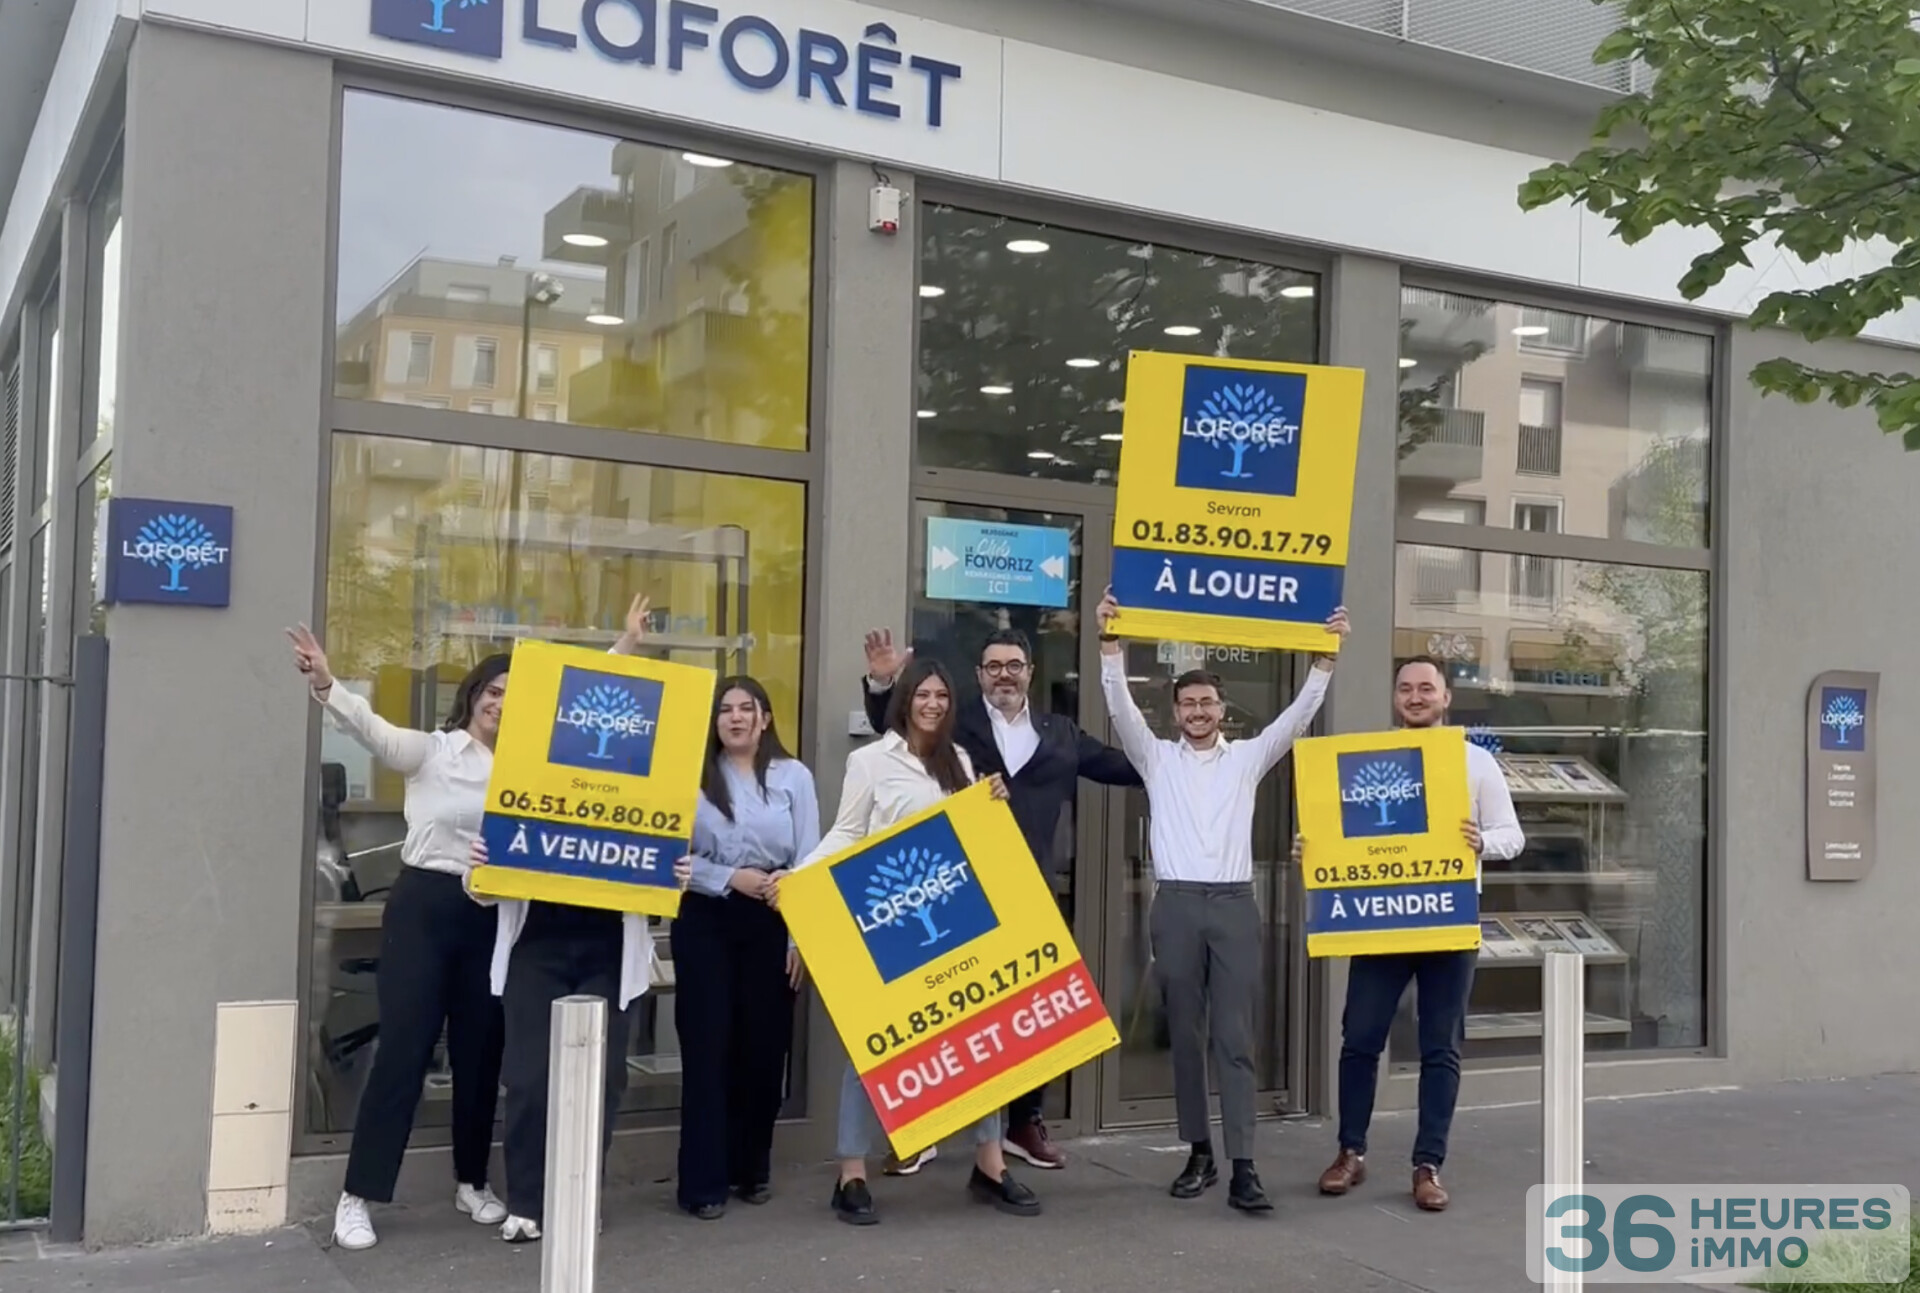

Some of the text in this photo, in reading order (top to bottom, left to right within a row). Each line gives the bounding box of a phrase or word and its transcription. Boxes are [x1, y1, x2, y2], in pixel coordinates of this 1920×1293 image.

[1206, 501, 1262, 518] Sevran
[1132, 519, 1332, 556] 01.83.90.17.79
[988, 580, 1010, 594] ICI
[1154, 558, 1299, 604] À LOUER
[571, 778, 620, 794] Sevran
[499, 790, 681, 832] 06.51.69.80.02
[508, 824, 660, 870] À VENDRE
[1367, 845, 1408, 856] Sevran
[1315, 858, 1464, 883] 01.83.90.17.79
[1330, 892, 1455, 919] À VENDRE
[924, 953, 980, 990] Sevran
[866, 942, 1060, 1056] 01.83.90.17.79
[877, 1040, 965, 1110] LOUÉ
[965, 1022, 1006, 1064] ET
[1011, 973, 1092, 1038] GÉRÉ
